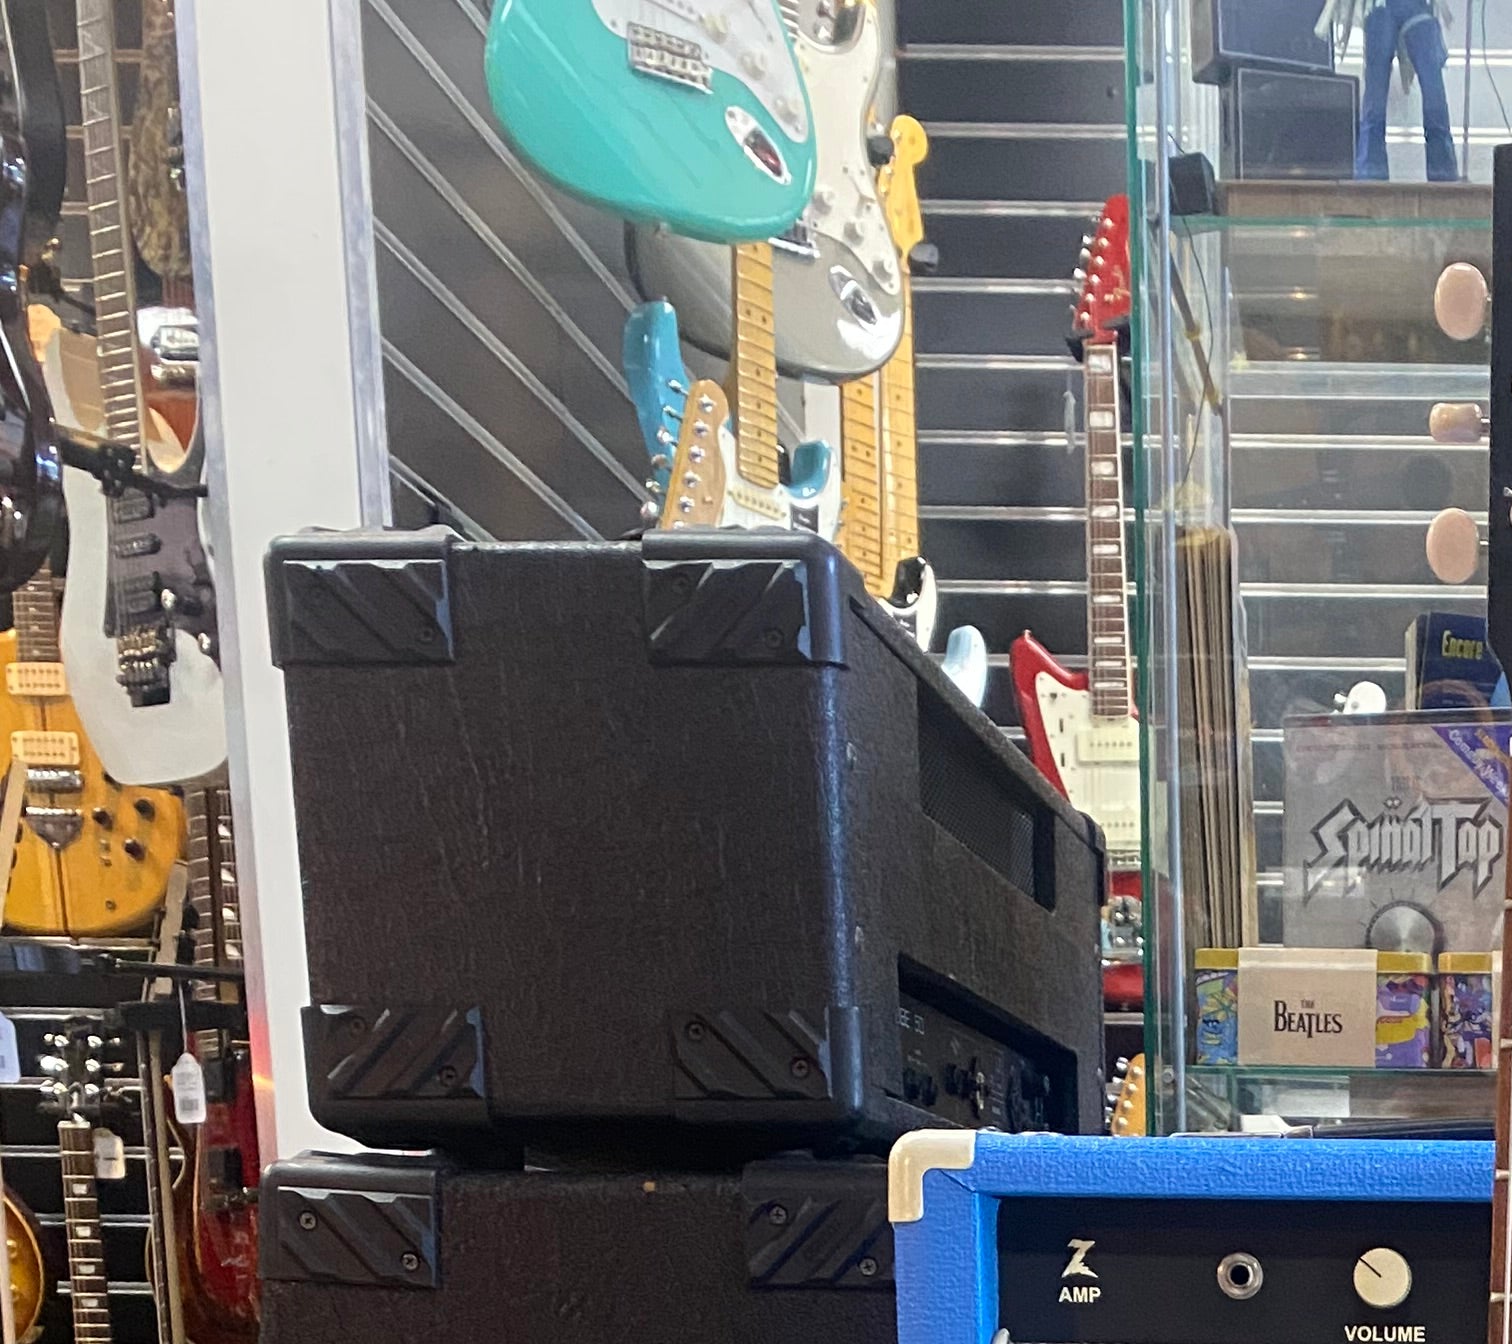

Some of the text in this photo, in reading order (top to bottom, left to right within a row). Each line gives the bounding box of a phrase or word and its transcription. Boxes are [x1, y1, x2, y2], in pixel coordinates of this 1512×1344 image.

[1441, 630, 1484, 660] Encore
[1274, 1000, 1343, 1038] BEATLES
[1058, 1286, 1101, 1303] AMP
[1344, 1325, 1426, 1343] VOLUME
